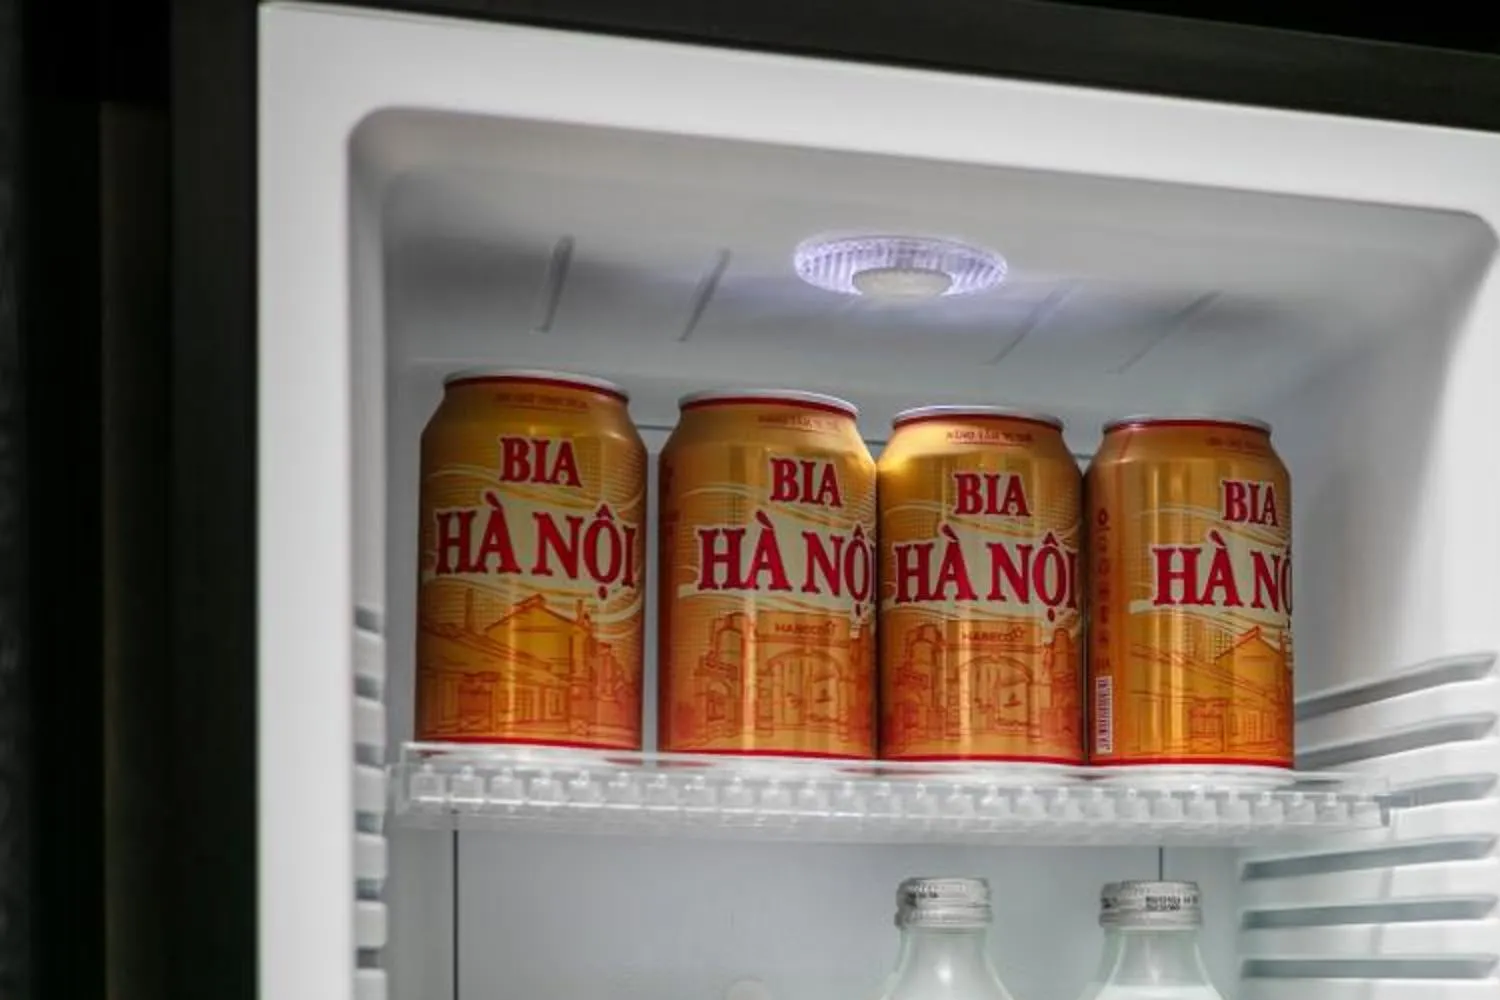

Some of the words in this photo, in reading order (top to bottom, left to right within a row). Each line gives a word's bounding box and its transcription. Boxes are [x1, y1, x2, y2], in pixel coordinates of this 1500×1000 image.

[500, 436, 582, 489] BIA
[769, 457, 842, 508] BIA
[954, 473, 1031, 517] BIA
[1222, 479, 1279, 527] BIA
[435, 491, 522, 576] HÀ
[531, 503, 636, 601] NỘI
[698, 510, 793, 592] HÀ
[895, 523, 978, 605] HÀ
[1152, 530, 1243, 607] HÀ
